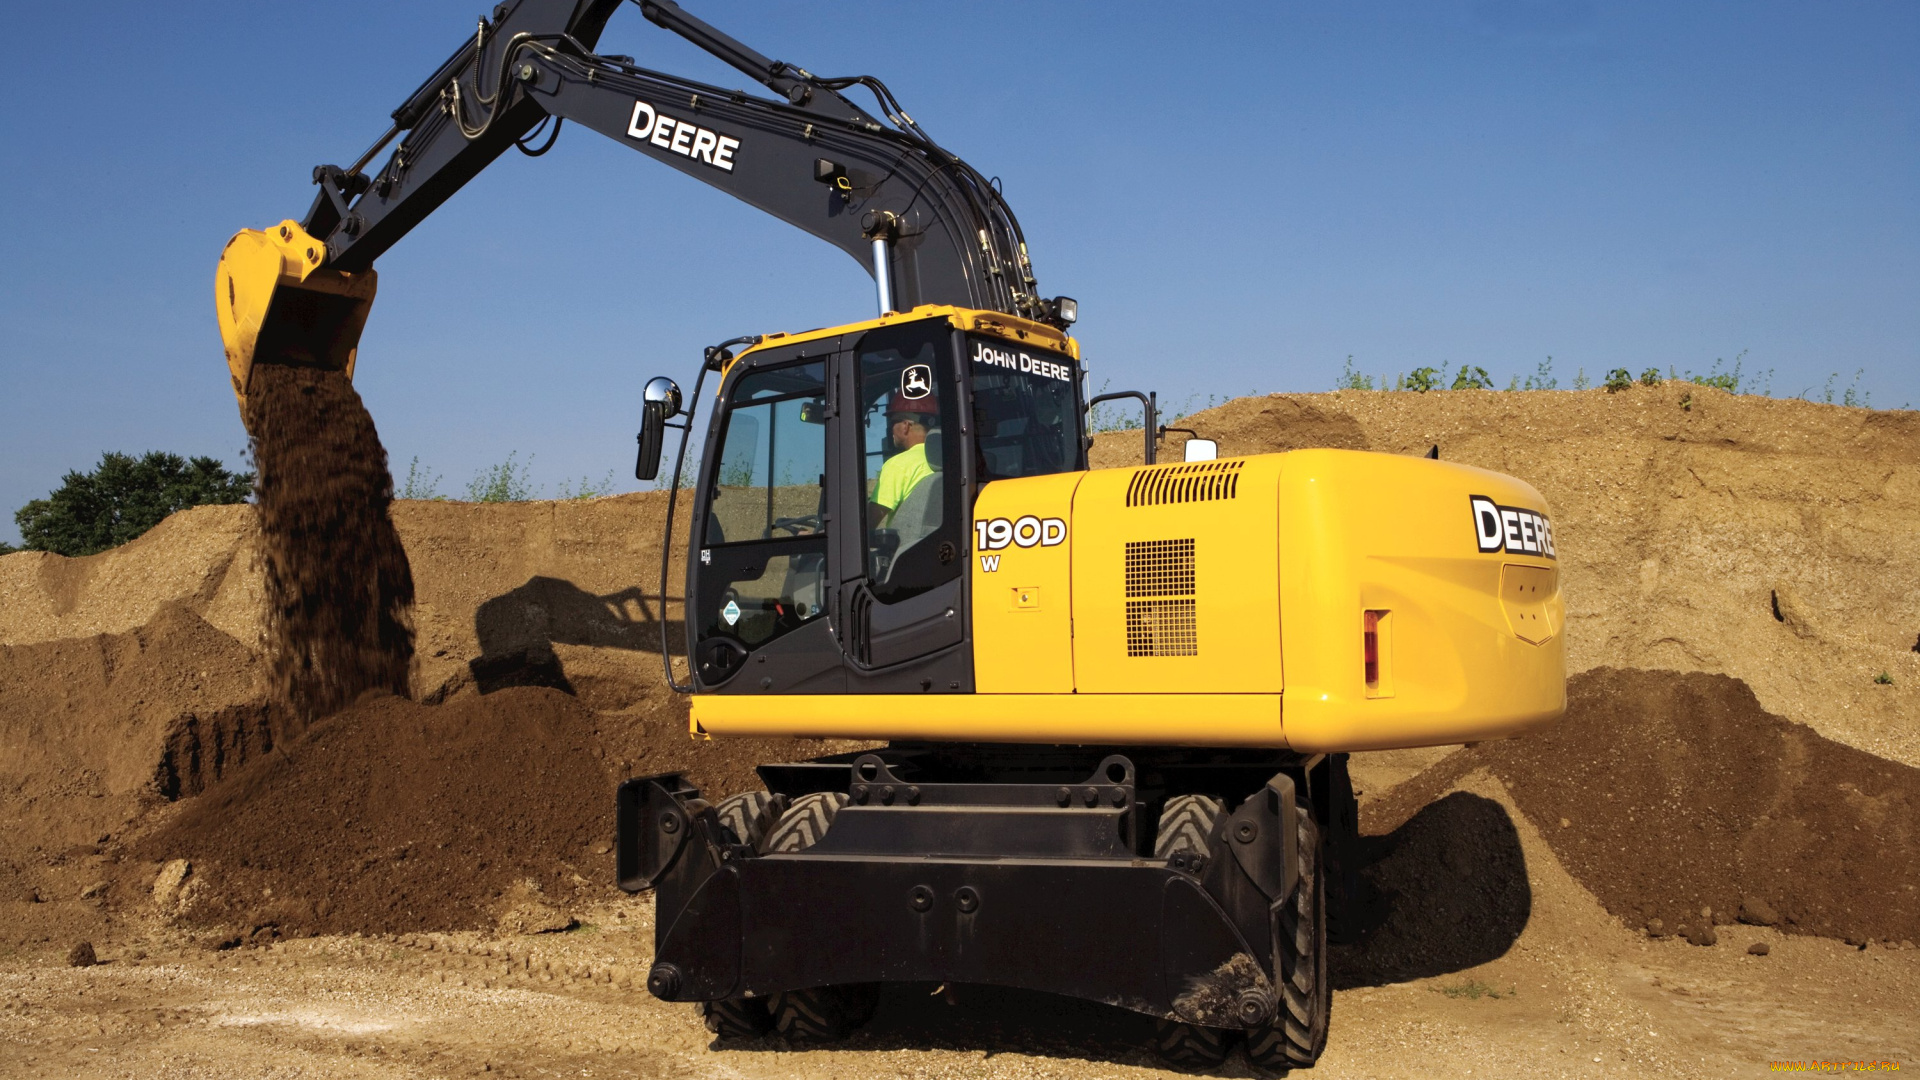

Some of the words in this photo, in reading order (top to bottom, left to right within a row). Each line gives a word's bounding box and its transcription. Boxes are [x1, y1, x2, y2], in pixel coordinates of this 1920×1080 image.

[627, 100, 740, 171] DEERE
[973, 343, 1017, 370] JOHN
[1020, 353, 1070, 381] DEERE
[975, 515, 1067, 551] 190D
[1471, 498, 1555, 556] DEERE
[980, 554, 1001, 573] W
